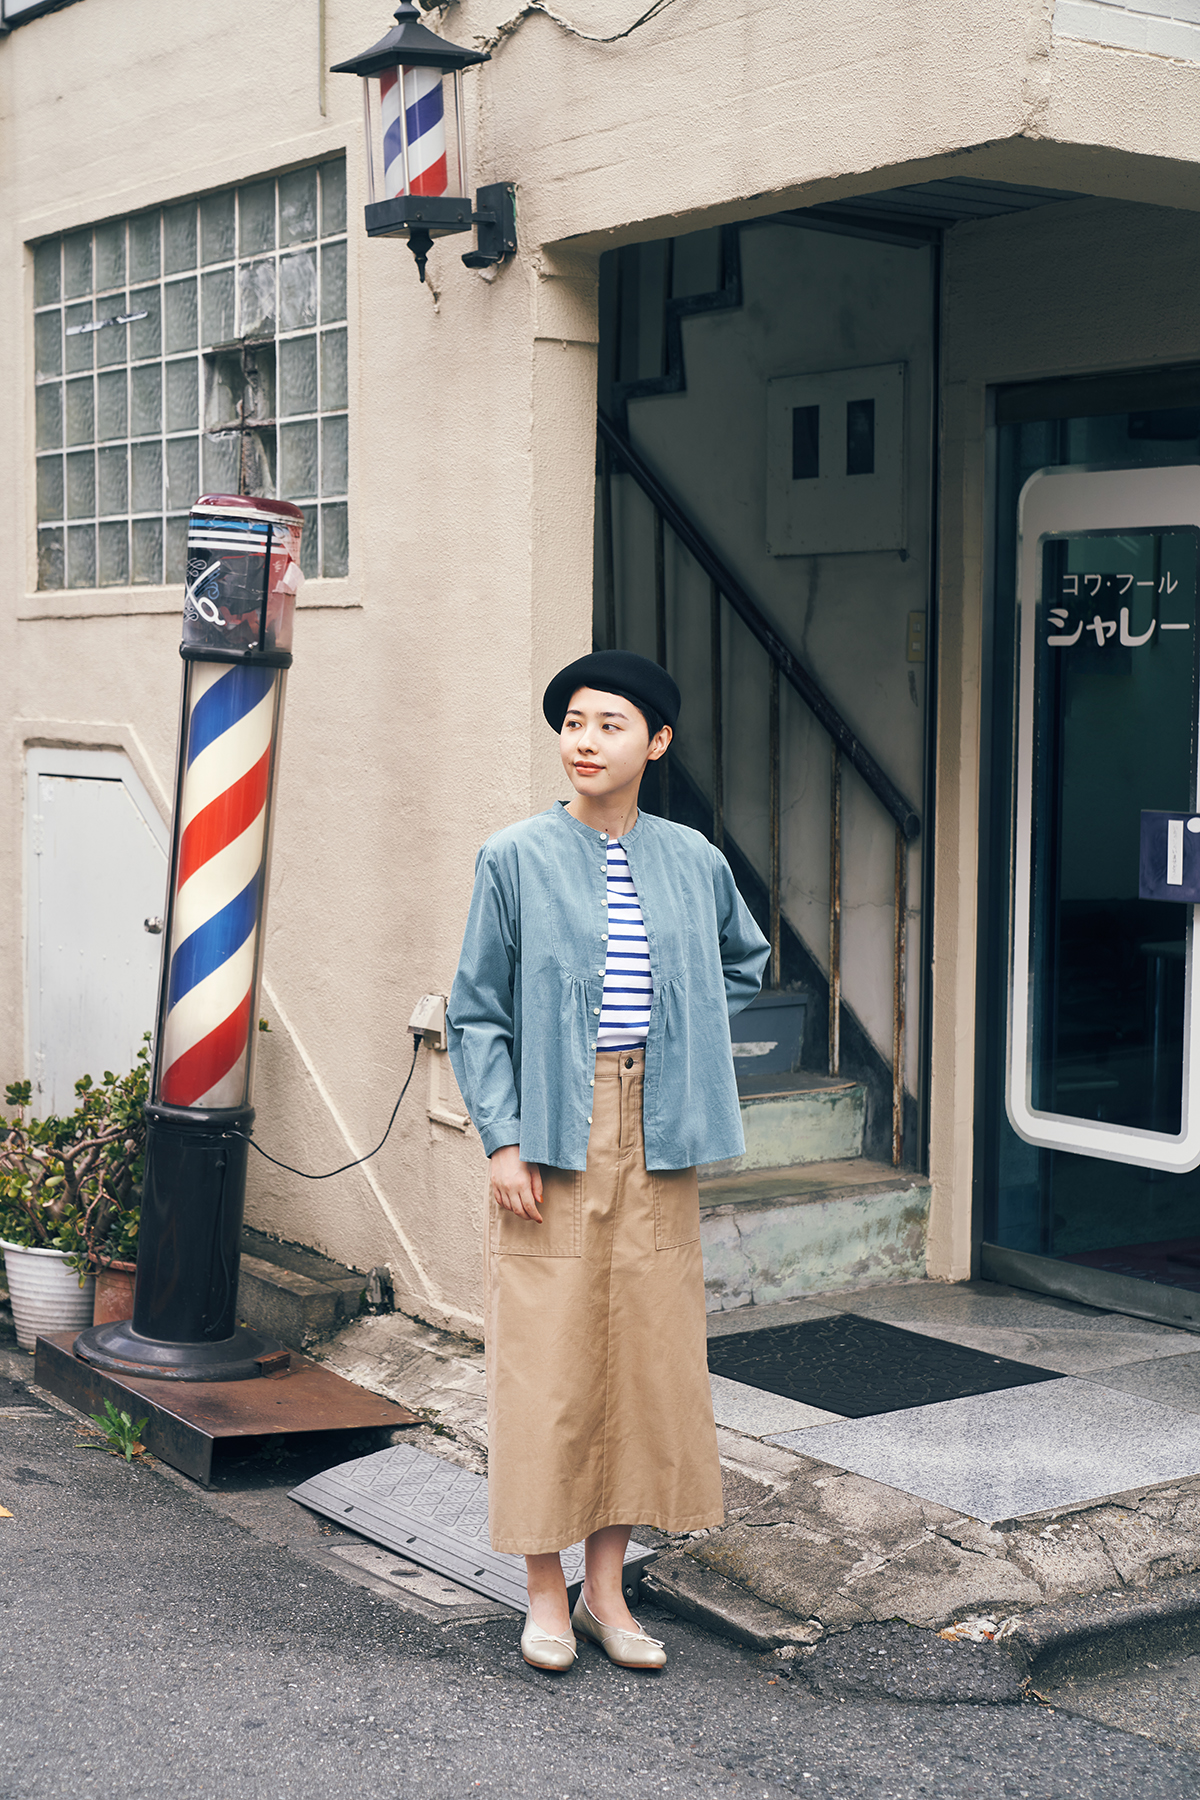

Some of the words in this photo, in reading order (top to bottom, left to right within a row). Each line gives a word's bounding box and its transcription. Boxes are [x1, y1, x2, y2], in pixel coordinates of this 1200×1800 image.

[1062, 571, 1179, 597] コワ・フール
[1046, 606, 1191, 647] シャレー
